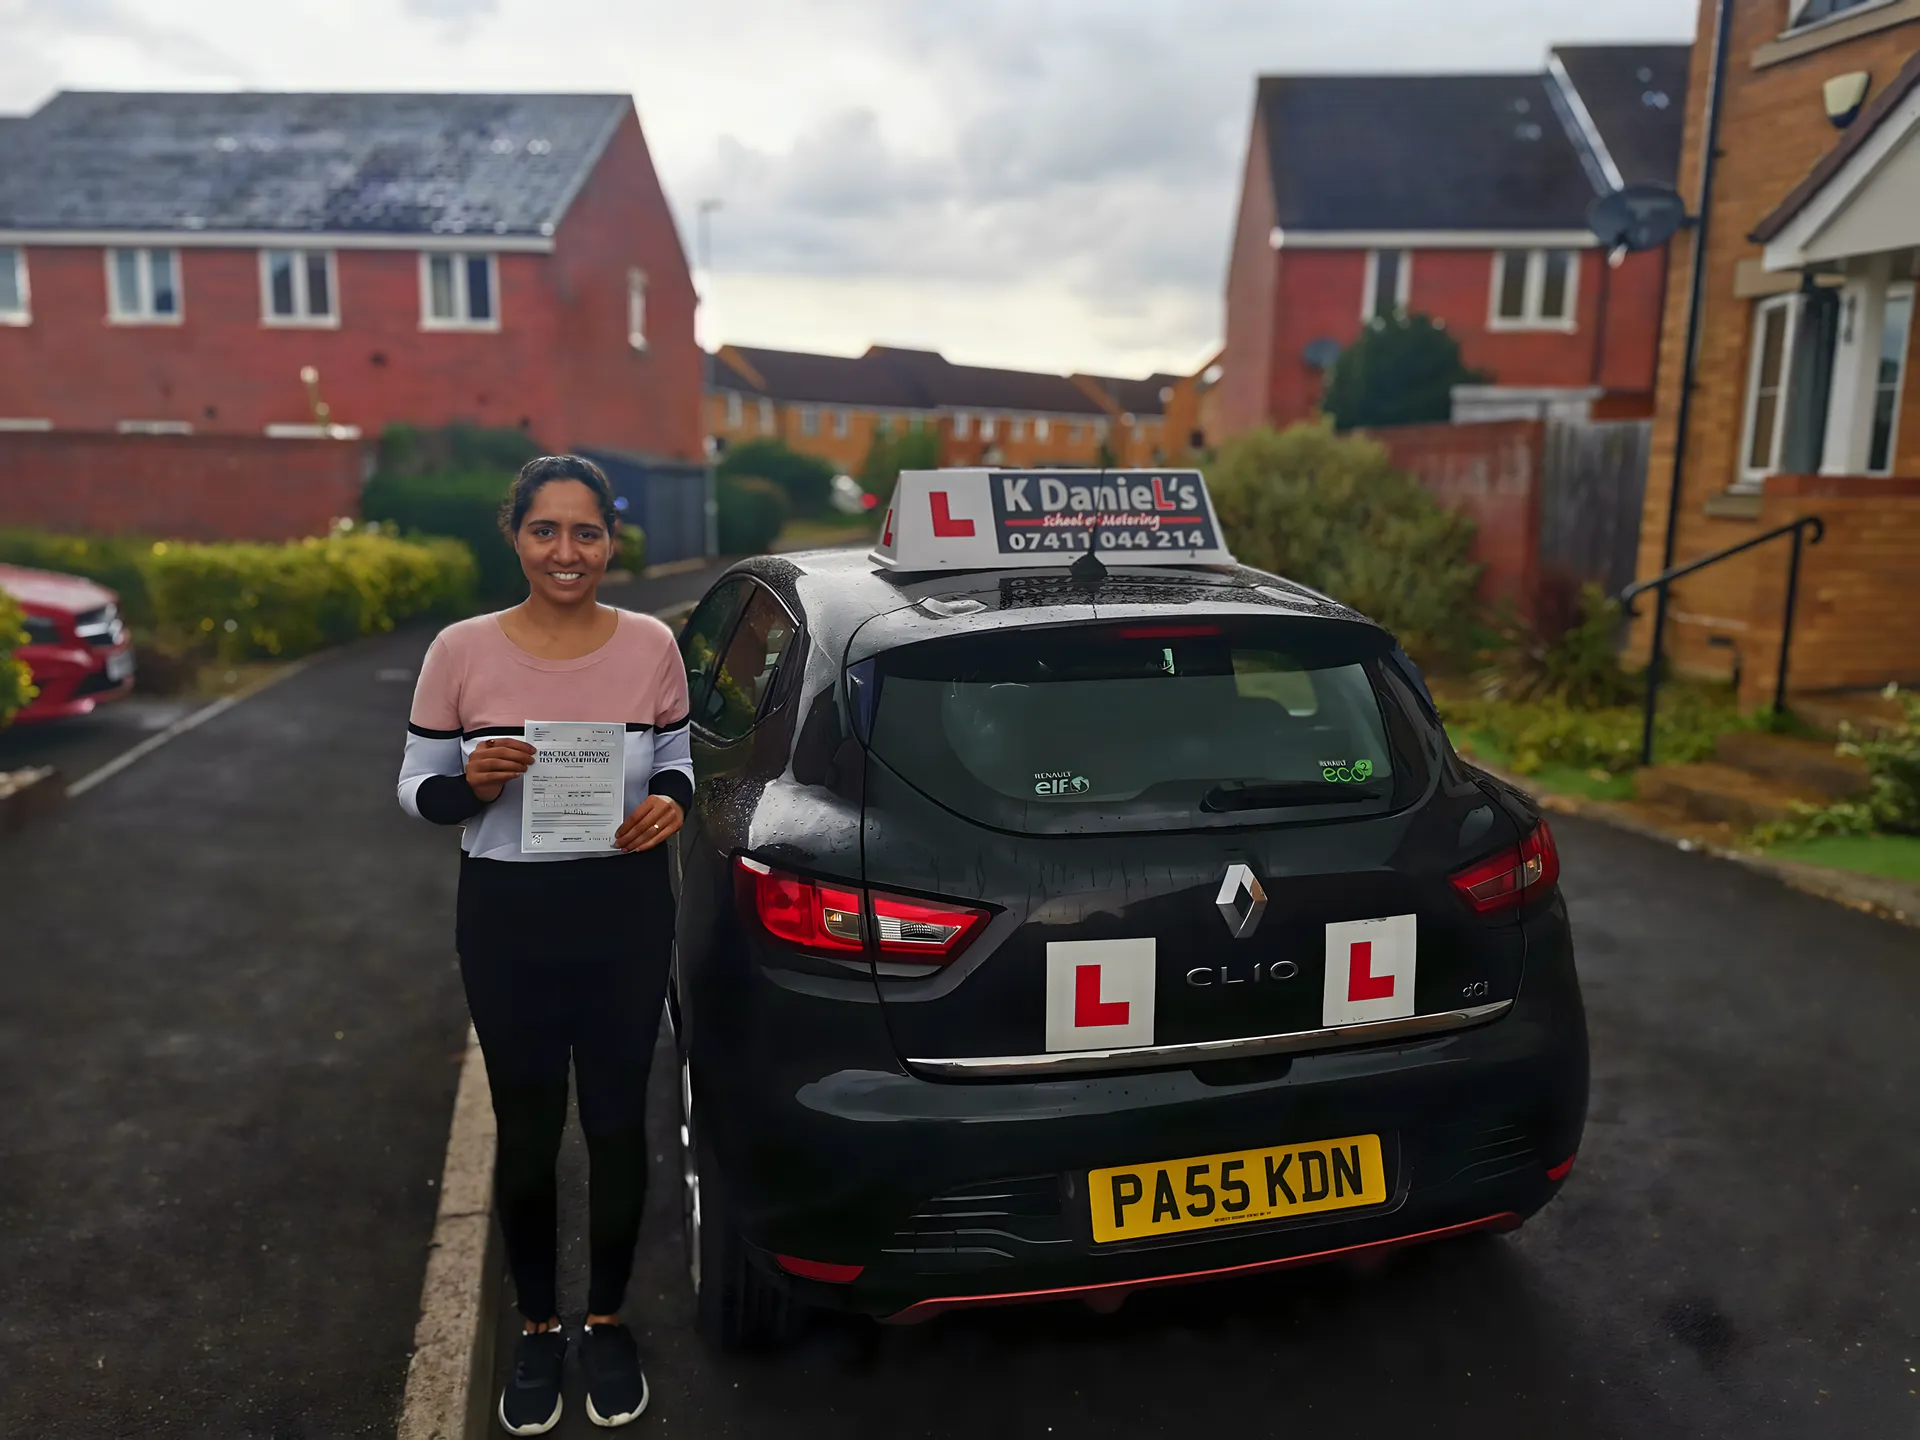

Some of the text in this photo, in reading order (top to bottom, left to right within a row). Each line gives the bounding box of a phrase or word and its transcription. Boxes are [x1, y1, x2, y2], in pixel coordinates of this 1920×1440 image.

[1002, 478, 1032, 512] K
[929, 492, 975, 537] L
[1042, 512, 1084, 527] School
[1008, 529, 1204, 550] 07411 044 214
[1034, 770, 1073, 779] RENAULT
[1034, 778, 1069, 794] elf
[1186, 960, 1299, 986] CLIO
[1348, 941, 1395, 1002] L
[1074, 965, 1130, 1028] L
[1111, 1145, 1363, 1228] PA55 KDN
